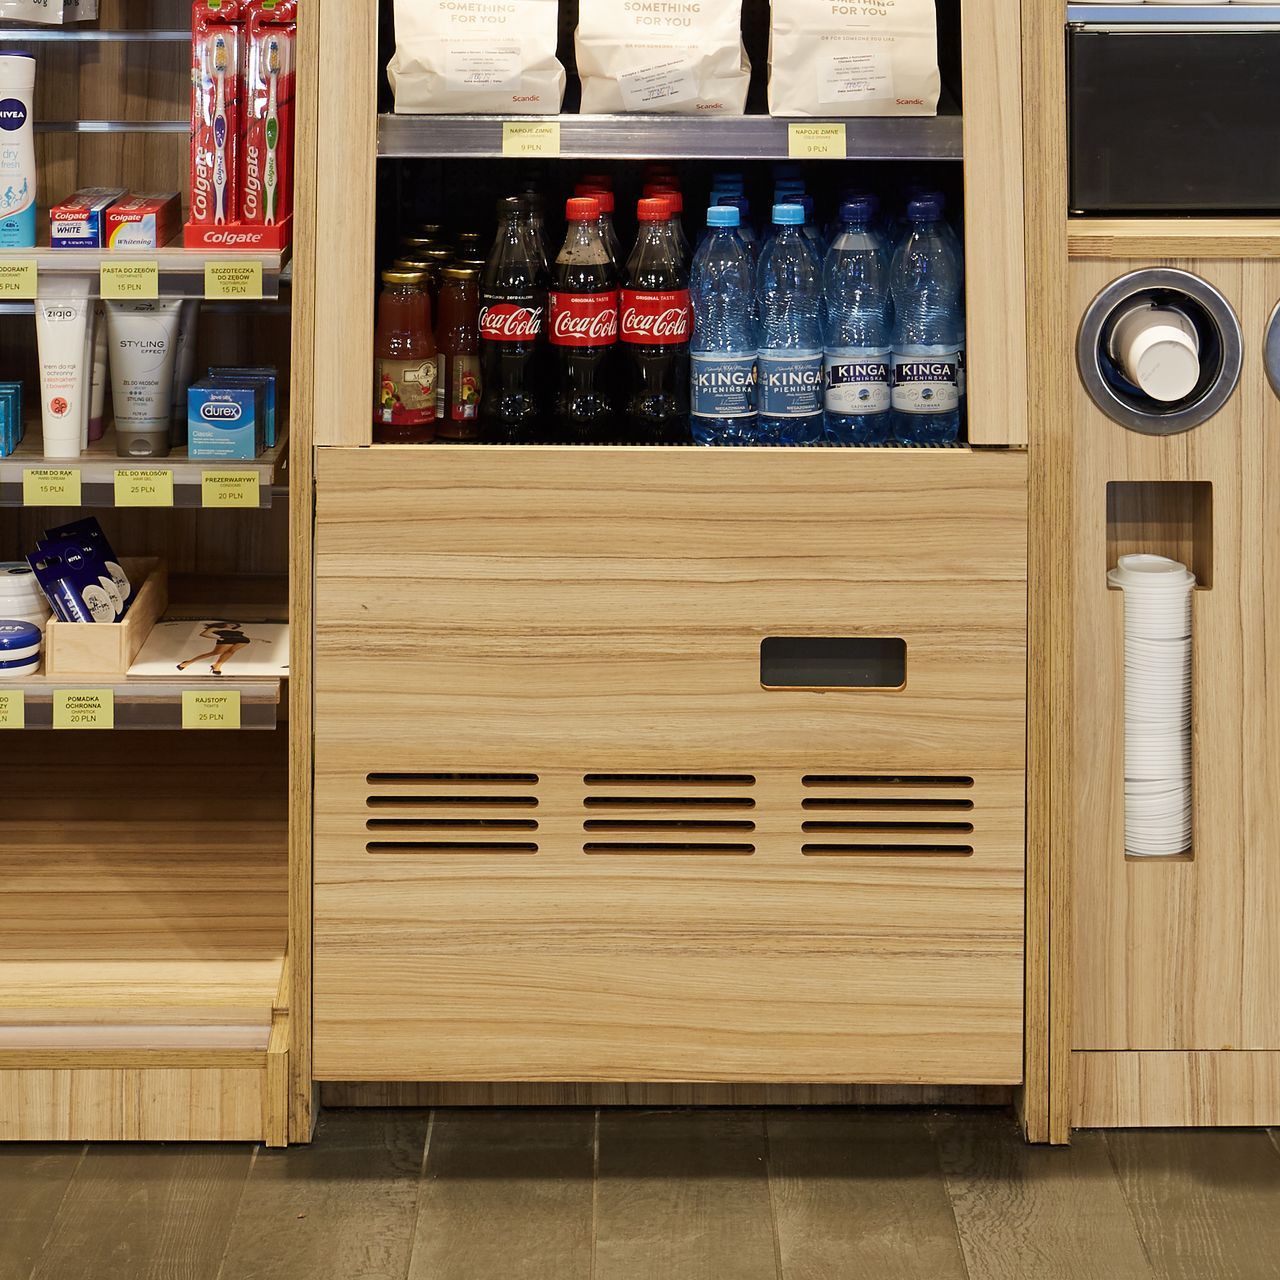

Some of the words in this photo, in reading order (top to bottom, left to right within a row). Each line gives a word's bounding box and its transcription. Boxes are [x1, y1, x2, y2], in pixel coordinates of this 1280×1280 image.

[439, 2, 515, 12] SOMETHING
[624, 3, 700, 13] SOMETHING
[832, 6, 857, 15] FOR
[860, 7, 887, 16] YOU
[451, 15, 476, 23] FOR
[480, 15, 506, 23] YOU
[636, 17, 662, 25] FOR
[665, 18, 691, 27] YOU
[3, 149, 18, 161] dry
[1, 160, 20, 169] fresh
[266, 157, 274, 187] Colgate
[193, 147, 210, 220] Colgate
[243, 146, 261, 219] Colgate
[55, 212, 89, 220] Colgate
[110, 214, 141, 222] Colgate
[203, 231, 262, 245] Colgate
[47, 310, 72, 319] ziaja
[478, 306, 544, 336] Coca-Cola
[555, 309, 617, 338] Coca-Cola
[622, 307, 687, 336] Coca-Cola
[838, 364, 886, 377] KINGA
[902, 364, 951, 375] KINGA
[699, 373, 754, 386] KINGA
[769, 372, 821, 386] KINGA
[703, 385, 752, 393] PIENIŃSKA
[205, 405, 237, 416] durex
